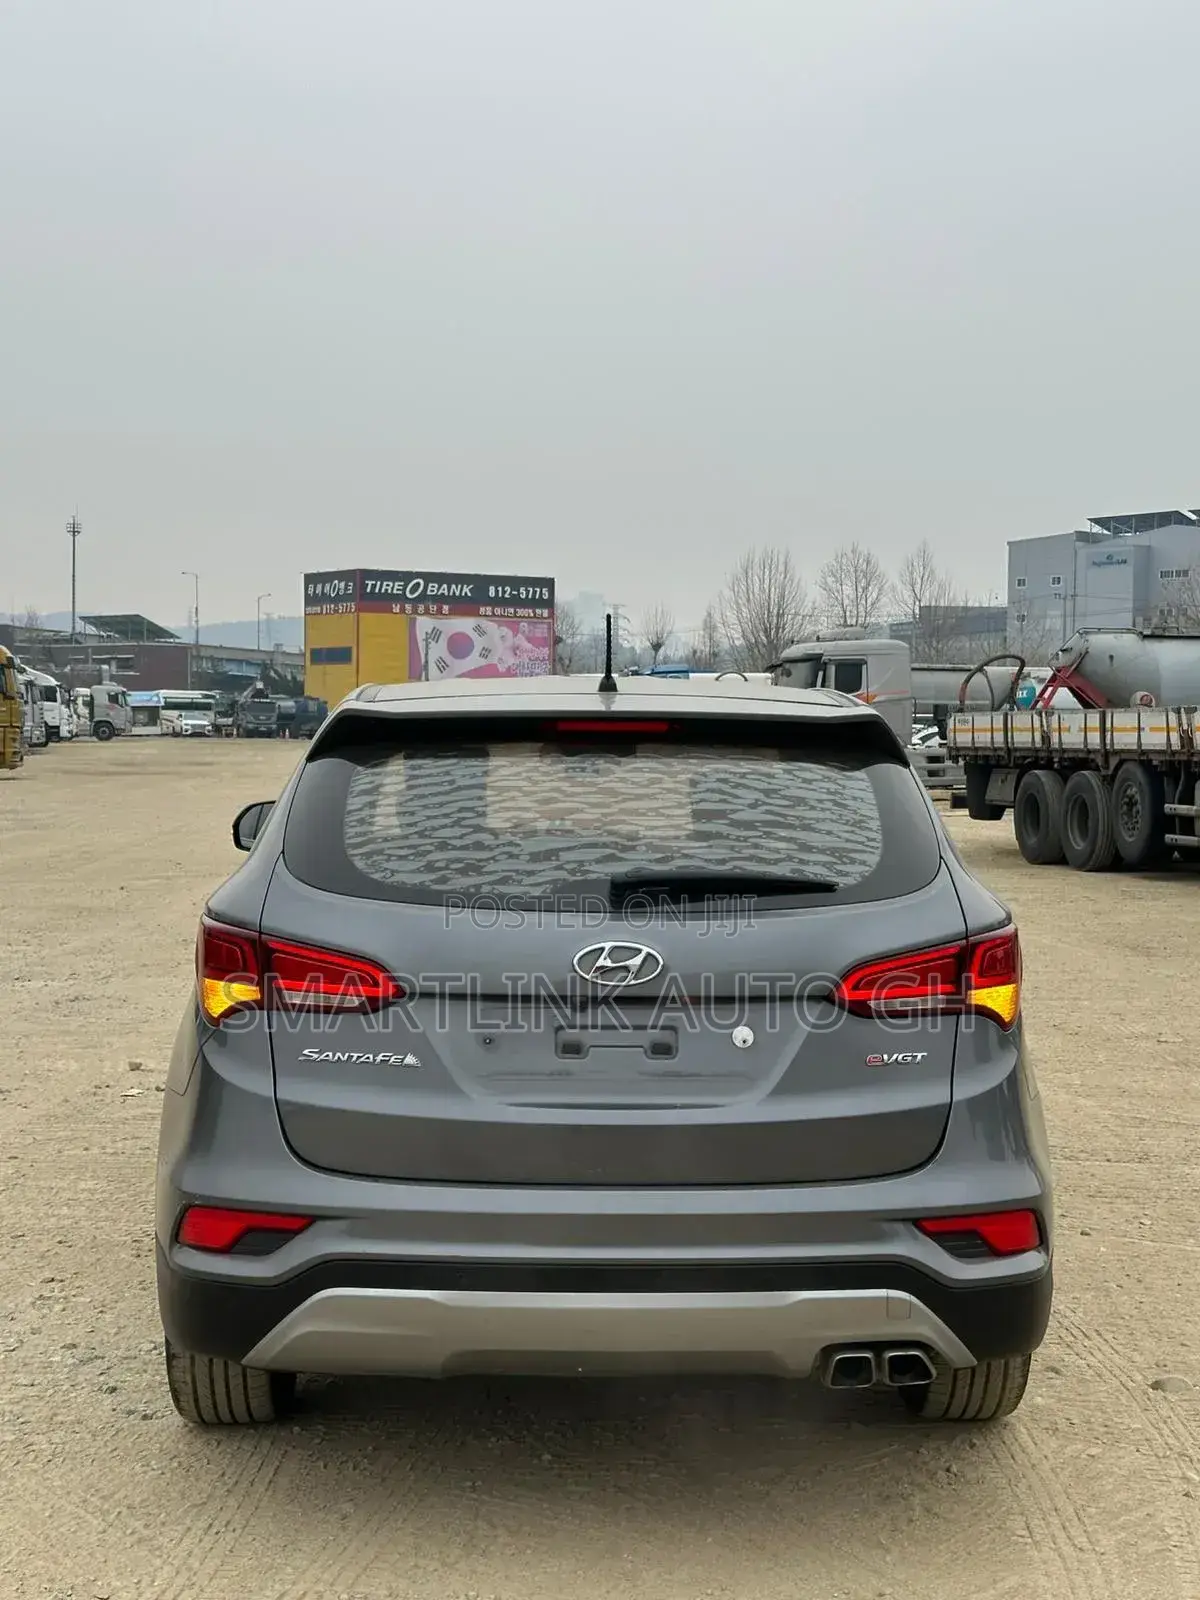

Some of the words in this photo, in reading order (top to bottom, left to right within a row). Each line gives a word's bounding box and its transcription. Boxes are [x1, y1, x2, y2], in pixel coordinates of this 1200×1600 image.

[365, 580, 404, 594] TIRE
[426, 582, 474, 597] BANK
[488, 585, 549, 600] 812-5775
